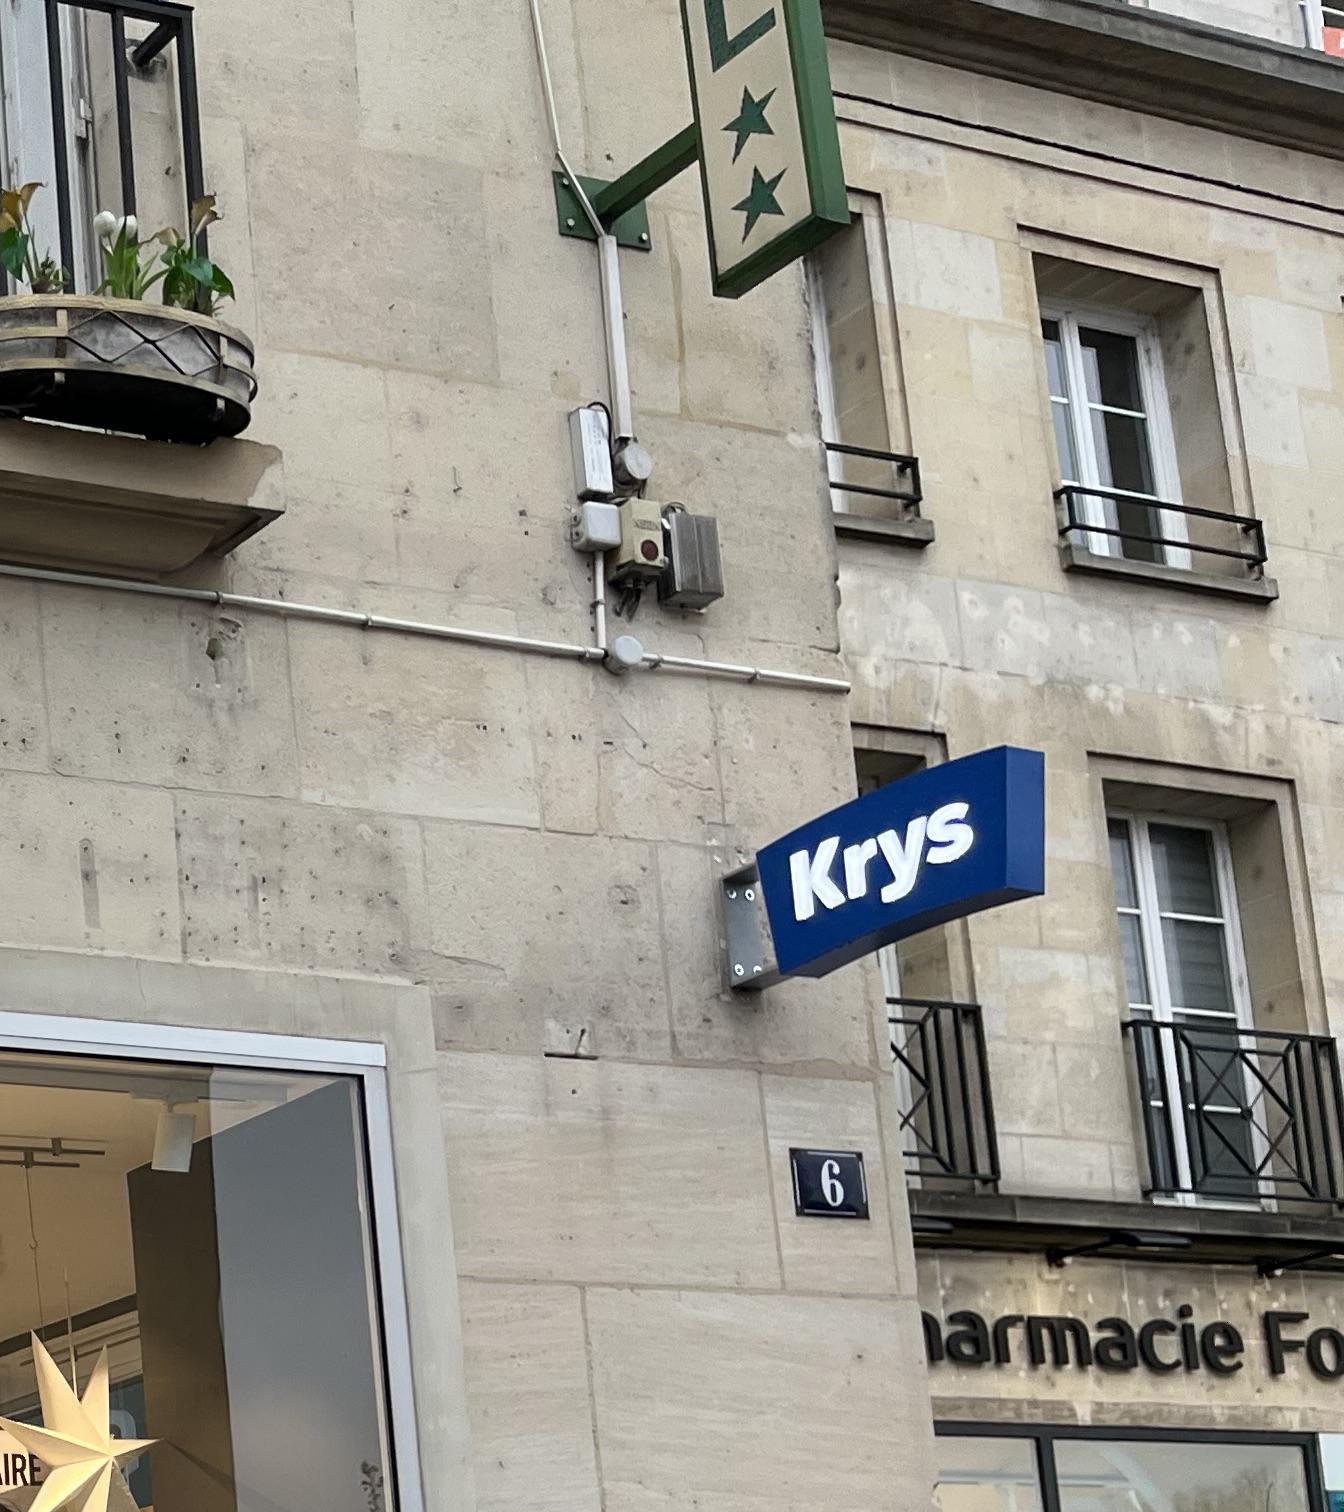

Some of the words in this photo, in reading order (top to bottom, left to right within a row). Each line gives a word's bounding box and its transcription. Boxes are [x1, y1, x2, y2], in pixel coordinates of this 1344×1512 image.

[789, 802, 974, 921] Krys
[821, 1159, 844, 1207] 6
[921, 1304, 1244, 1374] armacie
